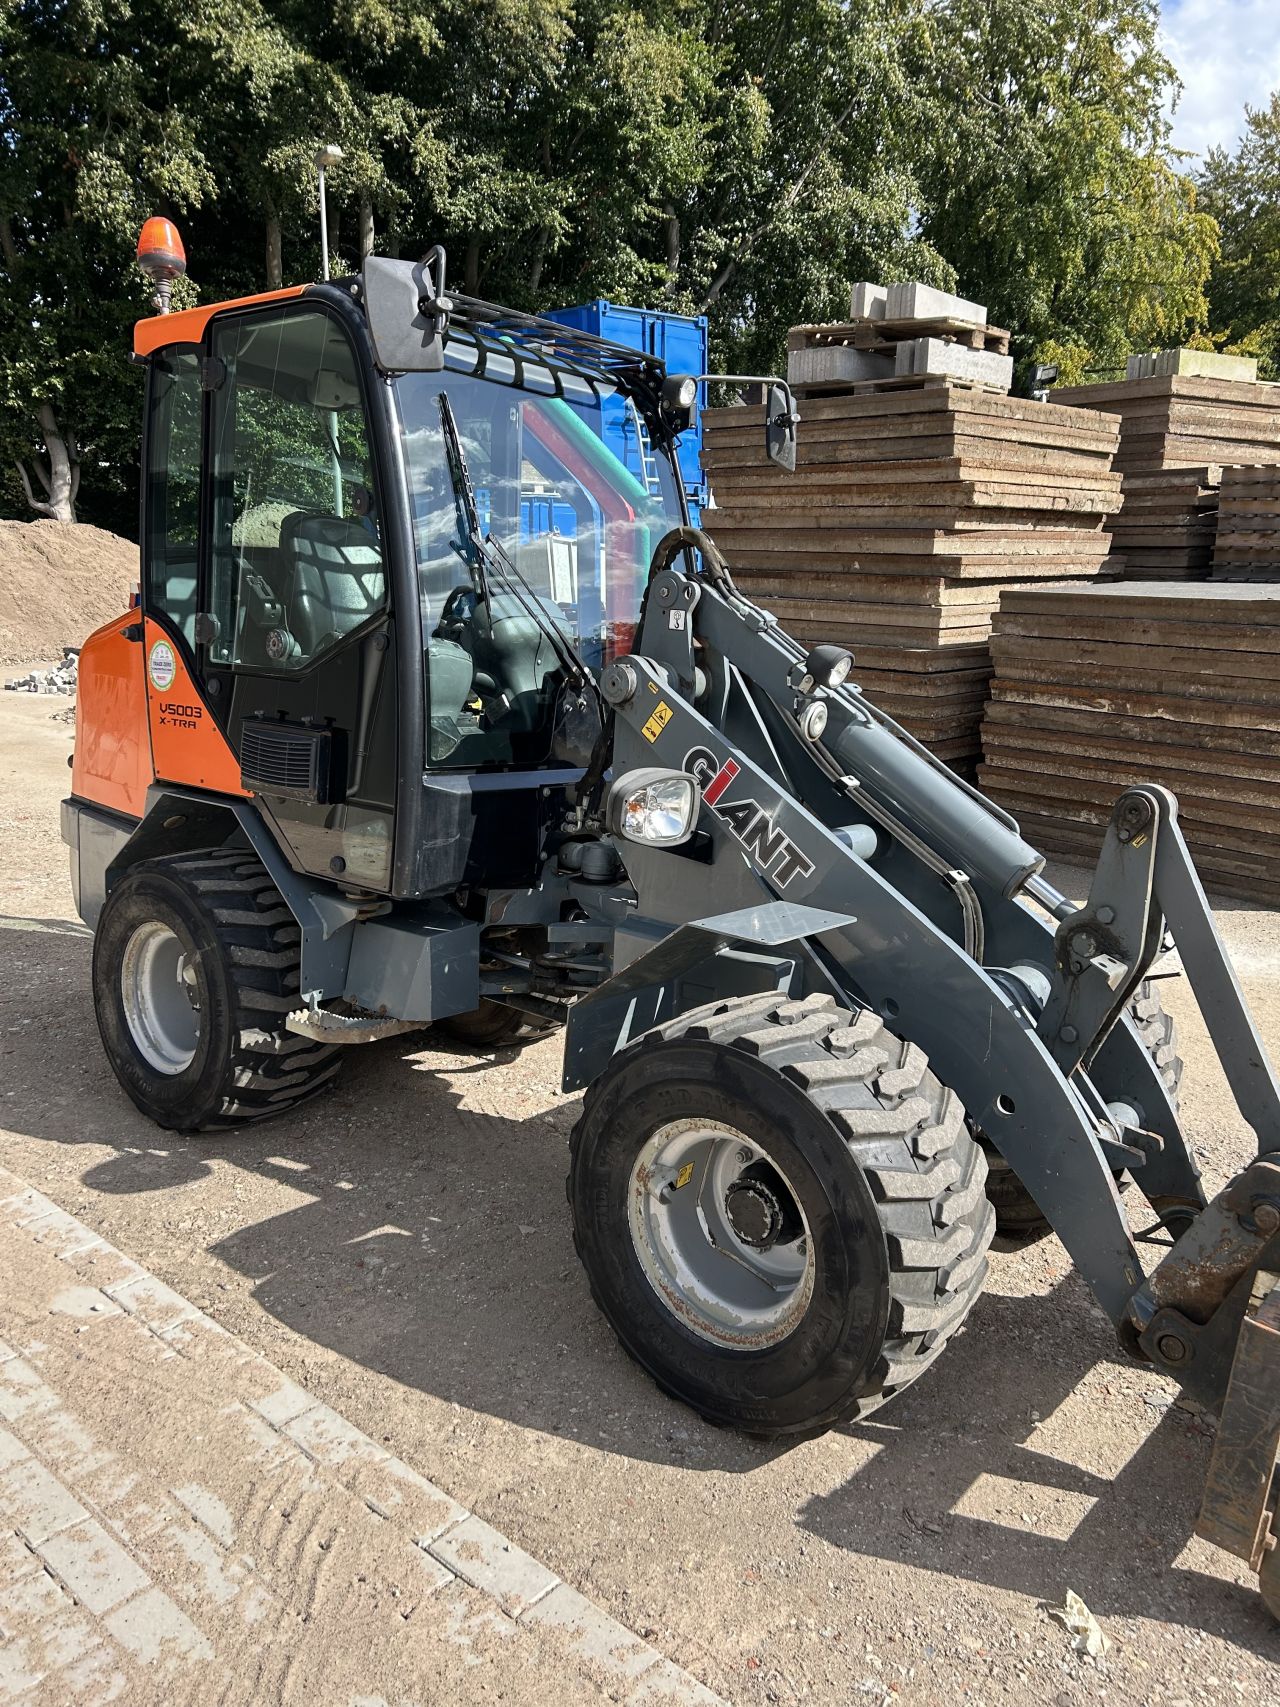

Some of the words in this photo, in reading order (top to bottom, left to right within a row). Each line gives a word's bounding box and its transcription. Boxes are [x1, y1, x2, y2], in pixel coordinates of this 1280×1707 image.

[160, 702, 202, 718] V5003
[160, 717, 197, 729] X-TRA
[682, 746, 816, 889] GIANT
